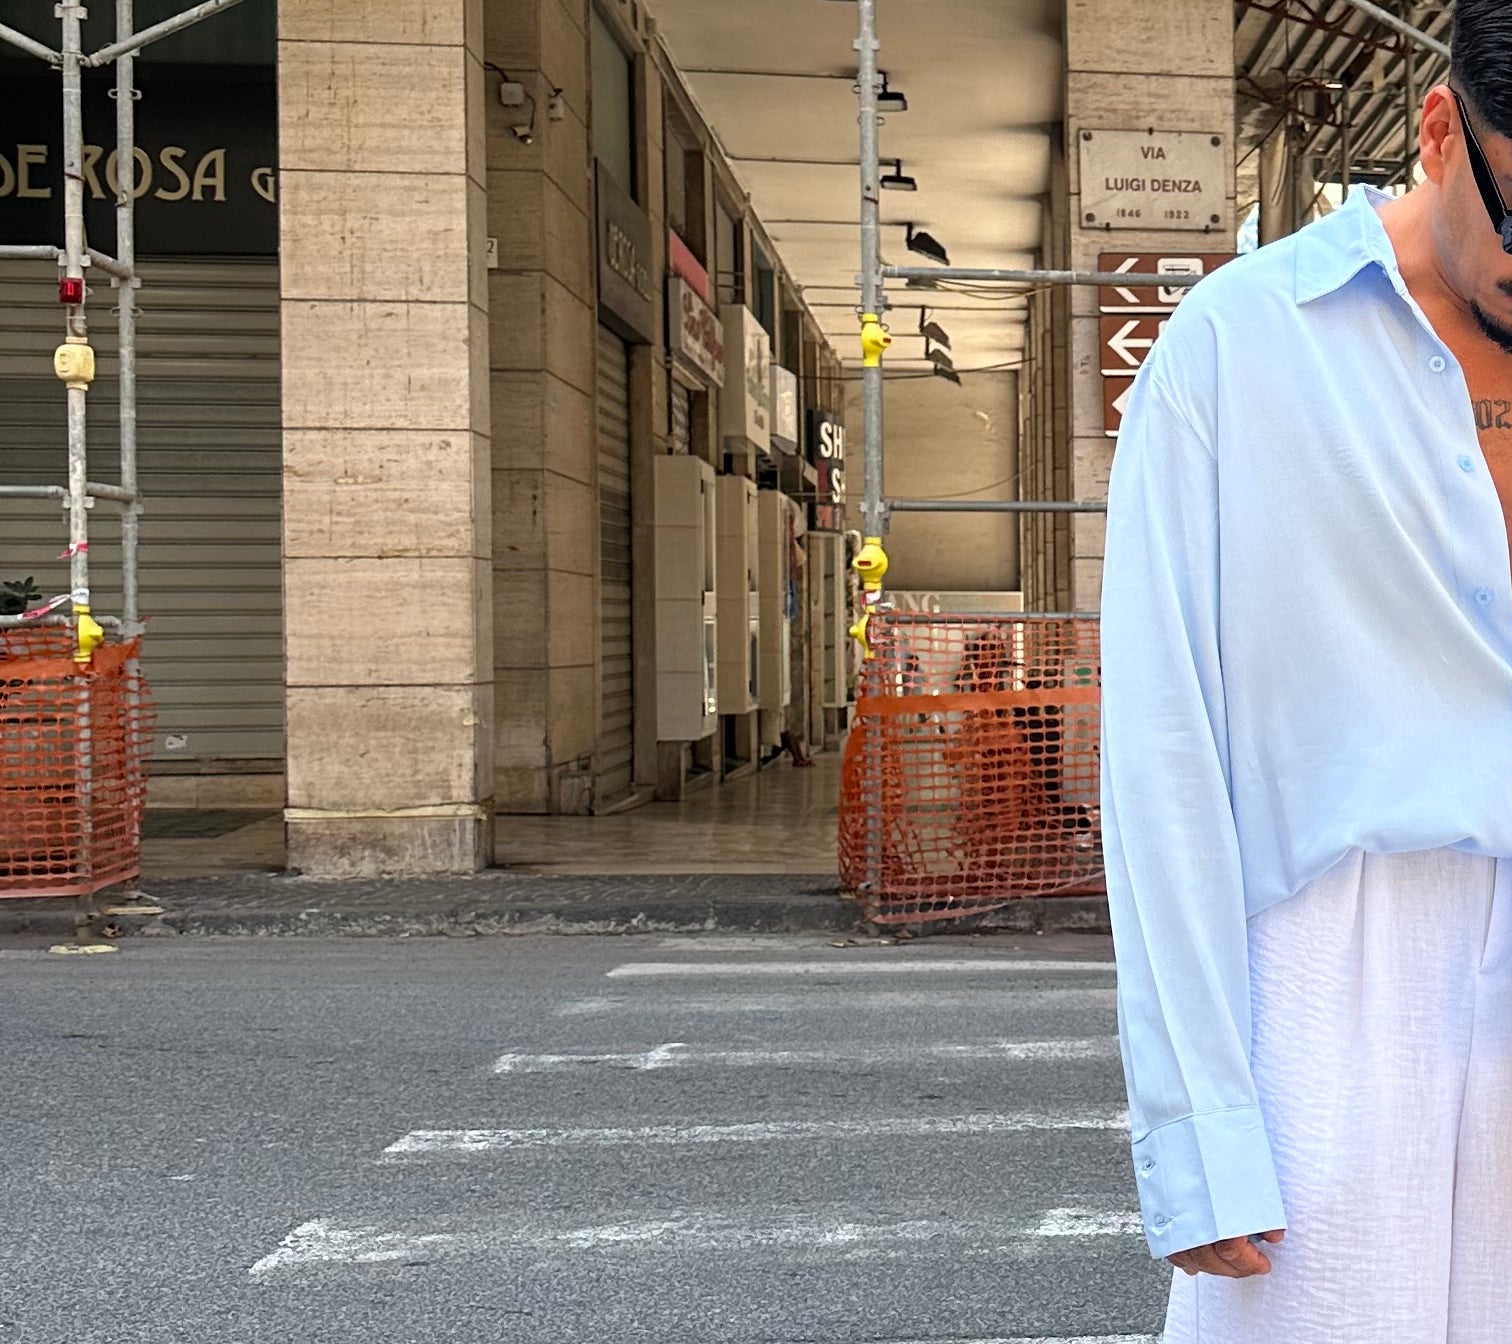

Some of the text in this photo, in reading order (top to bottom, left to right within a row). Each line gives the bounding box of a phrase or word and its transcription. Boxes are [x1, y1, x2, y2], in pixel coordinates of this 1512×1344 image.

[1140, 145, 1167, 160] VIA
[1105, 177, 1203, 194] LUIGI DENZA
[1116, 207, 1190, 220] 1846 1922
